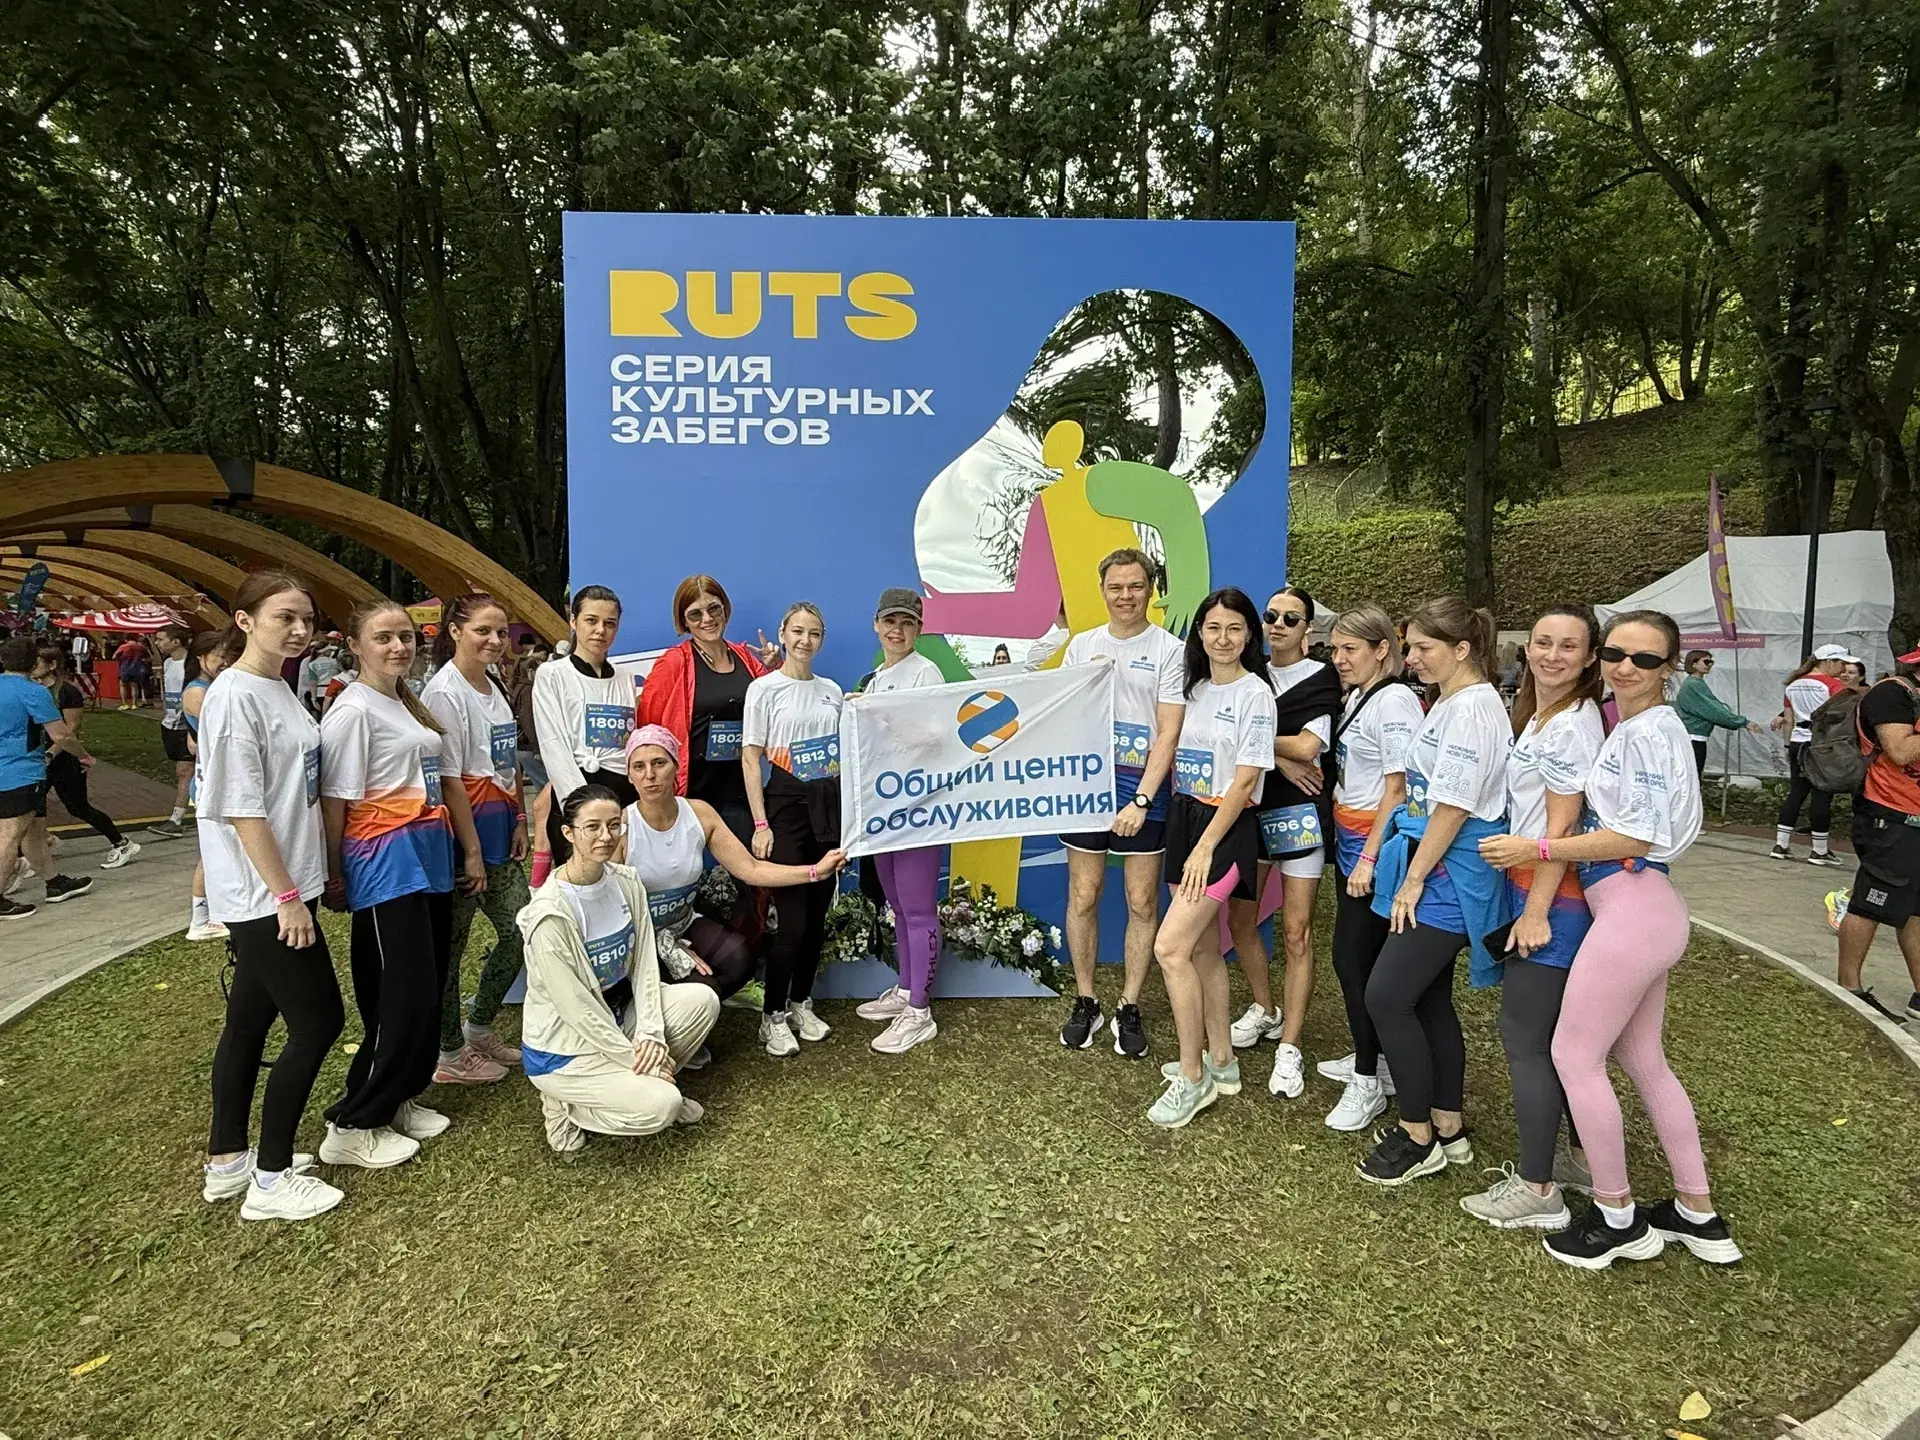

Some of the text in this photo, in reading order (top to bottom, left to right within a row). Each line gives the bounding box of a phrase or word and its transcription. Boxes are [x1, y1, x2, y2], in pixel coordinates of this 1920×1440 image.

[609, 269, 918, 341] RUTS
[609, 354, 772, 383] СЕРИЯ
[611, 385, 936, 416] КУЛЬТУРНЫХ
[610, 415, 831, 446] ЗАБЕГОВ
[588, 717, 625, 730] 1808
[711, 733, 742, 744] 1802
[1113, 735, 1130, 747] 98
[793, 750, 826, 765] 1812
[1446, 749, 1480, 764] НОВГОРОД
[1447, 744, 1477, 756] НИЖНИЙ
[1175, 761, 1200, 775] 1806
[1438, 760, 1464, 776] 20
[875, 753, 1103, 800] Общий центр
[866, 790, 1114, 836] обслуживания
[1263, 819, 1300, 835] 1796
[650, 897, 685, 918] 1804
[590, 944, 626, 968] 1810
